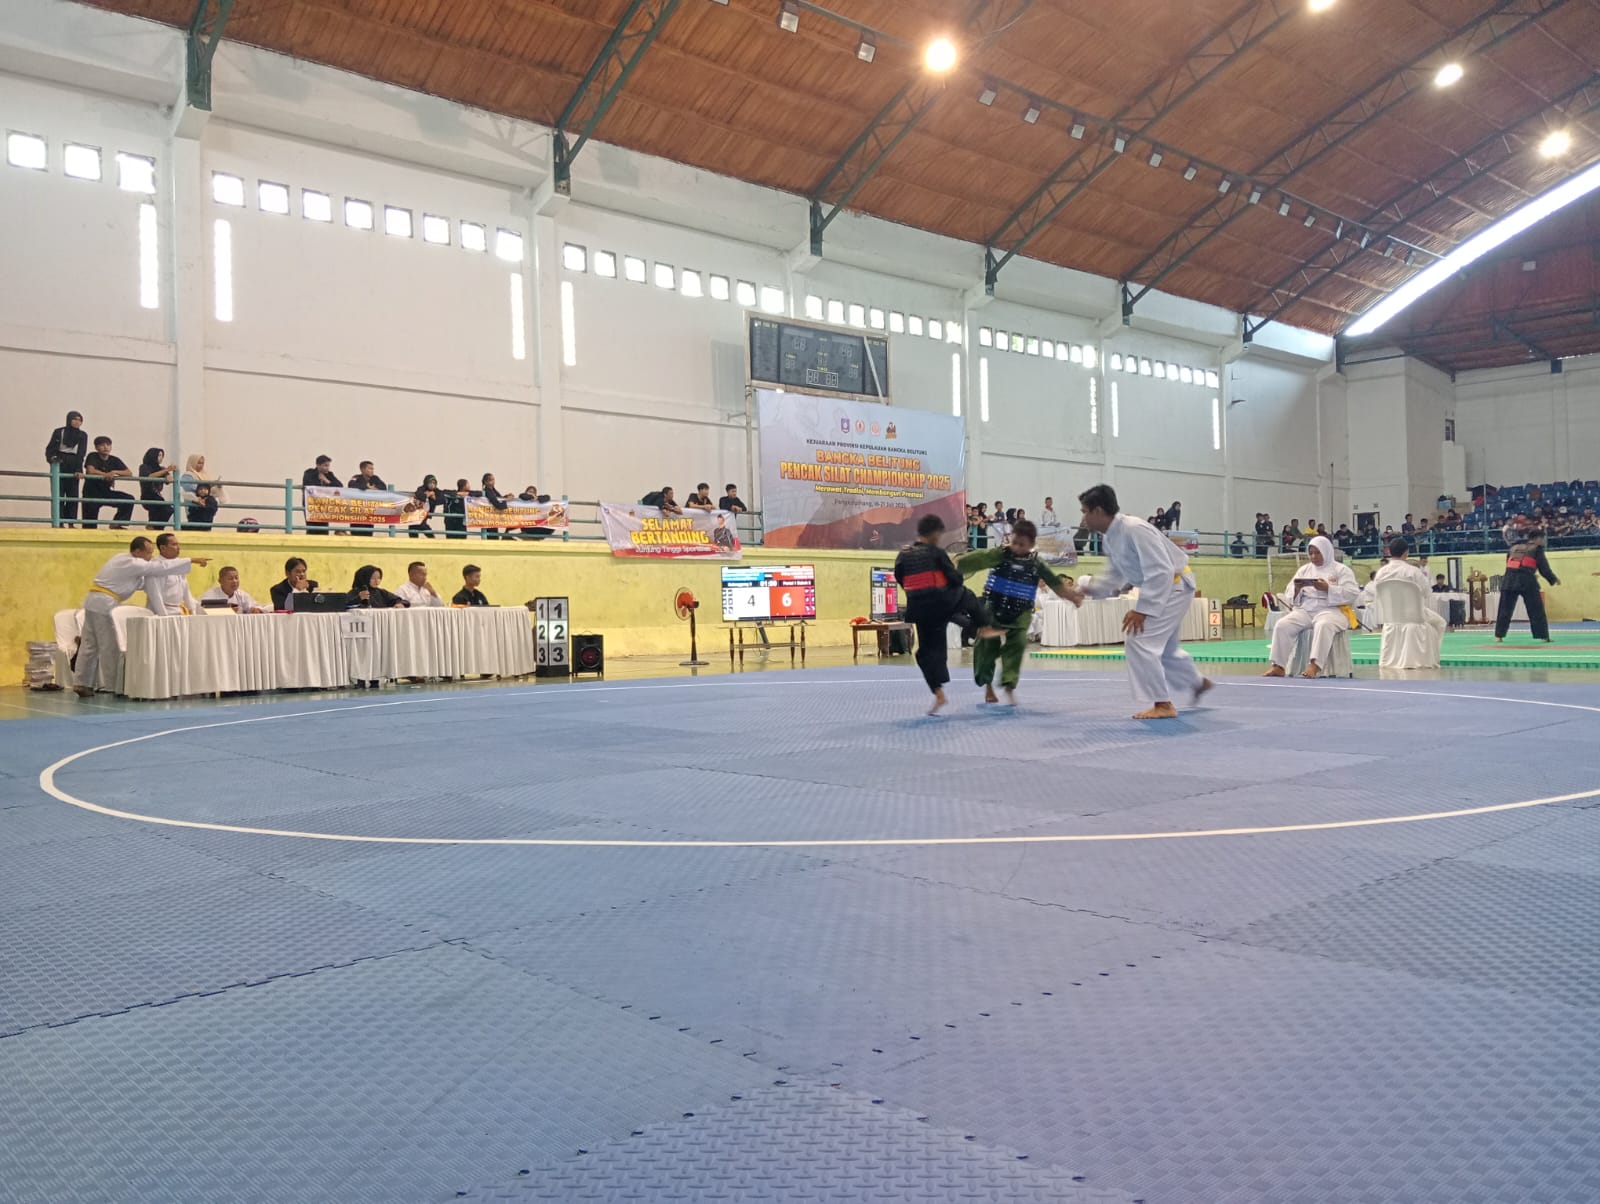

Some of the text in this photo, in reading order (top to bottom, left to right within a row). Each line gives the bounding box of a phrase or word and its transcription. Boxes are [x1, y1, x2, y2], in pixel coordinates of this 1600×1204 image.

[815, 449, 920, 471] BANGKA BELITUNG
[780, 461, 951, 490] PENCAK SILAT CHAMPIONSHIP 2025
[308, 504, 376, 515] PENCAK SILAT
[309, 513, 367, 522] CHAMPIONSHIP
[641, 518, 694, 531] SELAMAT
[630, 530, 710, 545] BERTANDING
[747, 592, 792, 607] 4 6
[1212, 600, 1217, 610] 1
[539, 603, 544, 619] 1
[554, 603, 562, 619] 1
[1212, 614, 1218, 624] 2
[538, 624, 546, 640] 2
[554, 624, 565, 640] 2
[1212, 627, 1218, 637] 3
[538, 647, 546, 663] 3
[552, 646, 564, 663] 3
